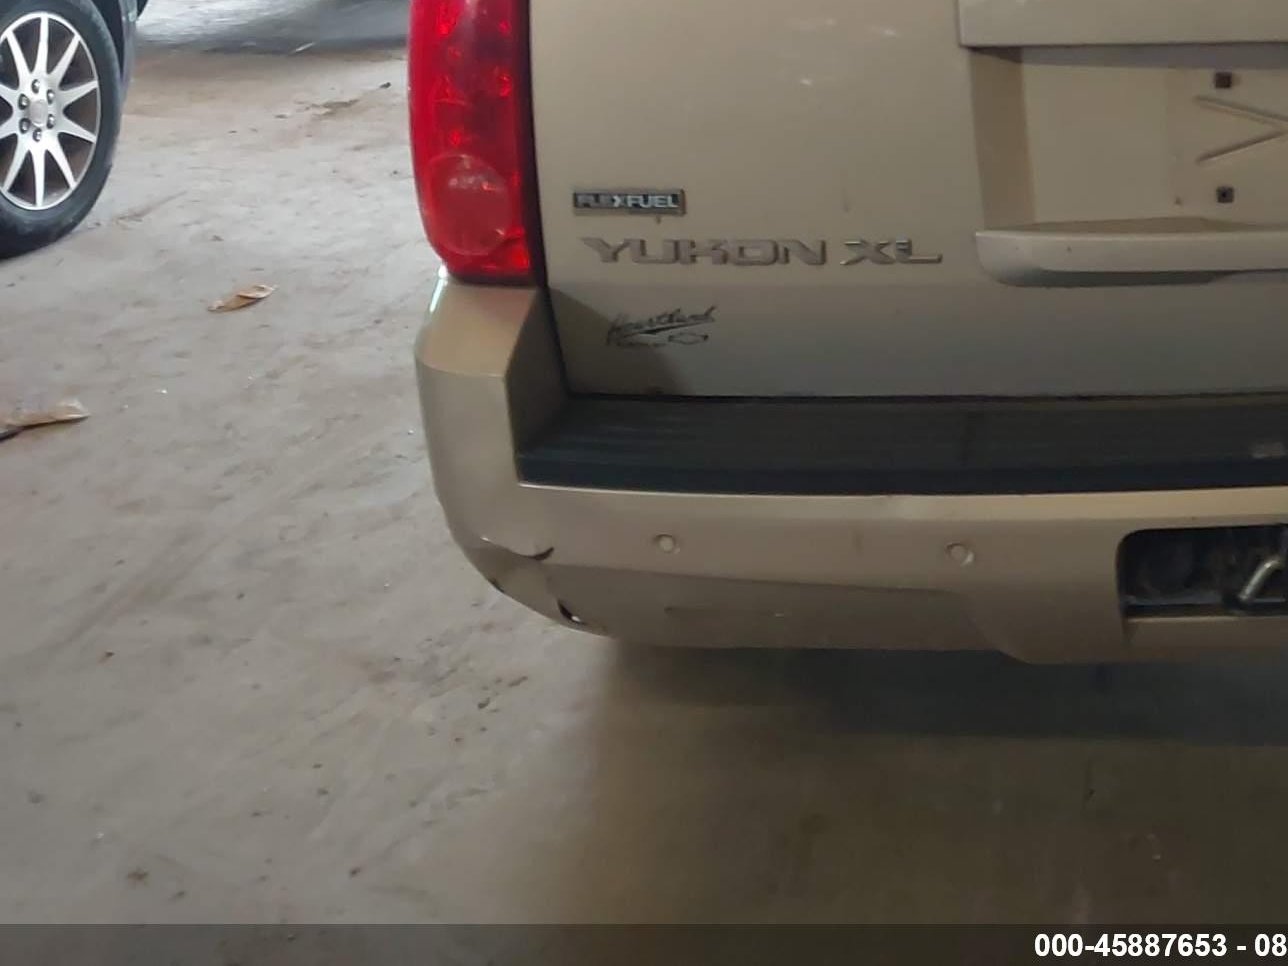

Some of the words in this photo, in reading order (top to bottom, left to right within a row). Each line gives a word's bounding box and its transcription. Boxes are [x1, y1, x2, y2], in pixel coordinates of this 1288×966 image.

[576, 193, 681, 209] FLEXFUEL
[581, 236, 827, 266] YUKON
[839, 236, 944, 266] XL
